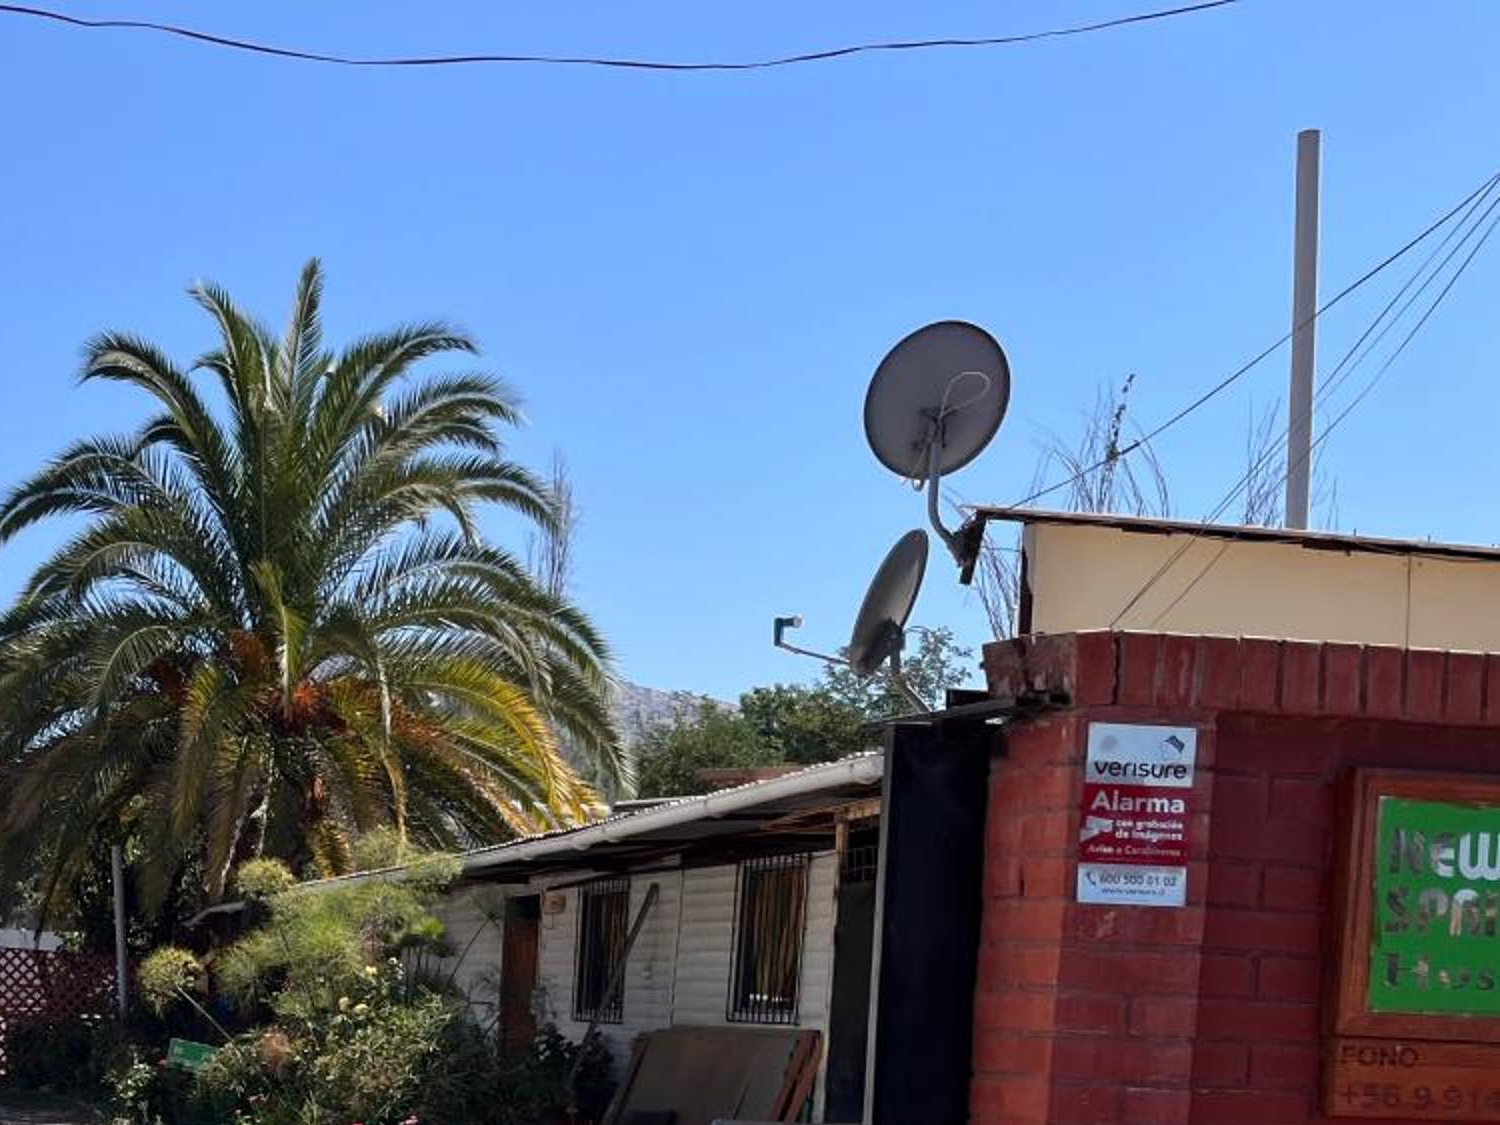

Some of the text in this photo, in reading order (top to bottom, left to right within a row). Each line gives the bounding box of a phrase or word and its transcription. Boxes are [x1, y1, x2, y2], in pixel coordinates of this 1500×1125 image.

[1094, 760, 1187, 779] verisure
[1091, 789, 1186, 814] Alarma
[1115, 829, 1129, 839] de
[1341, 1045, 1419, 1067] FONO
